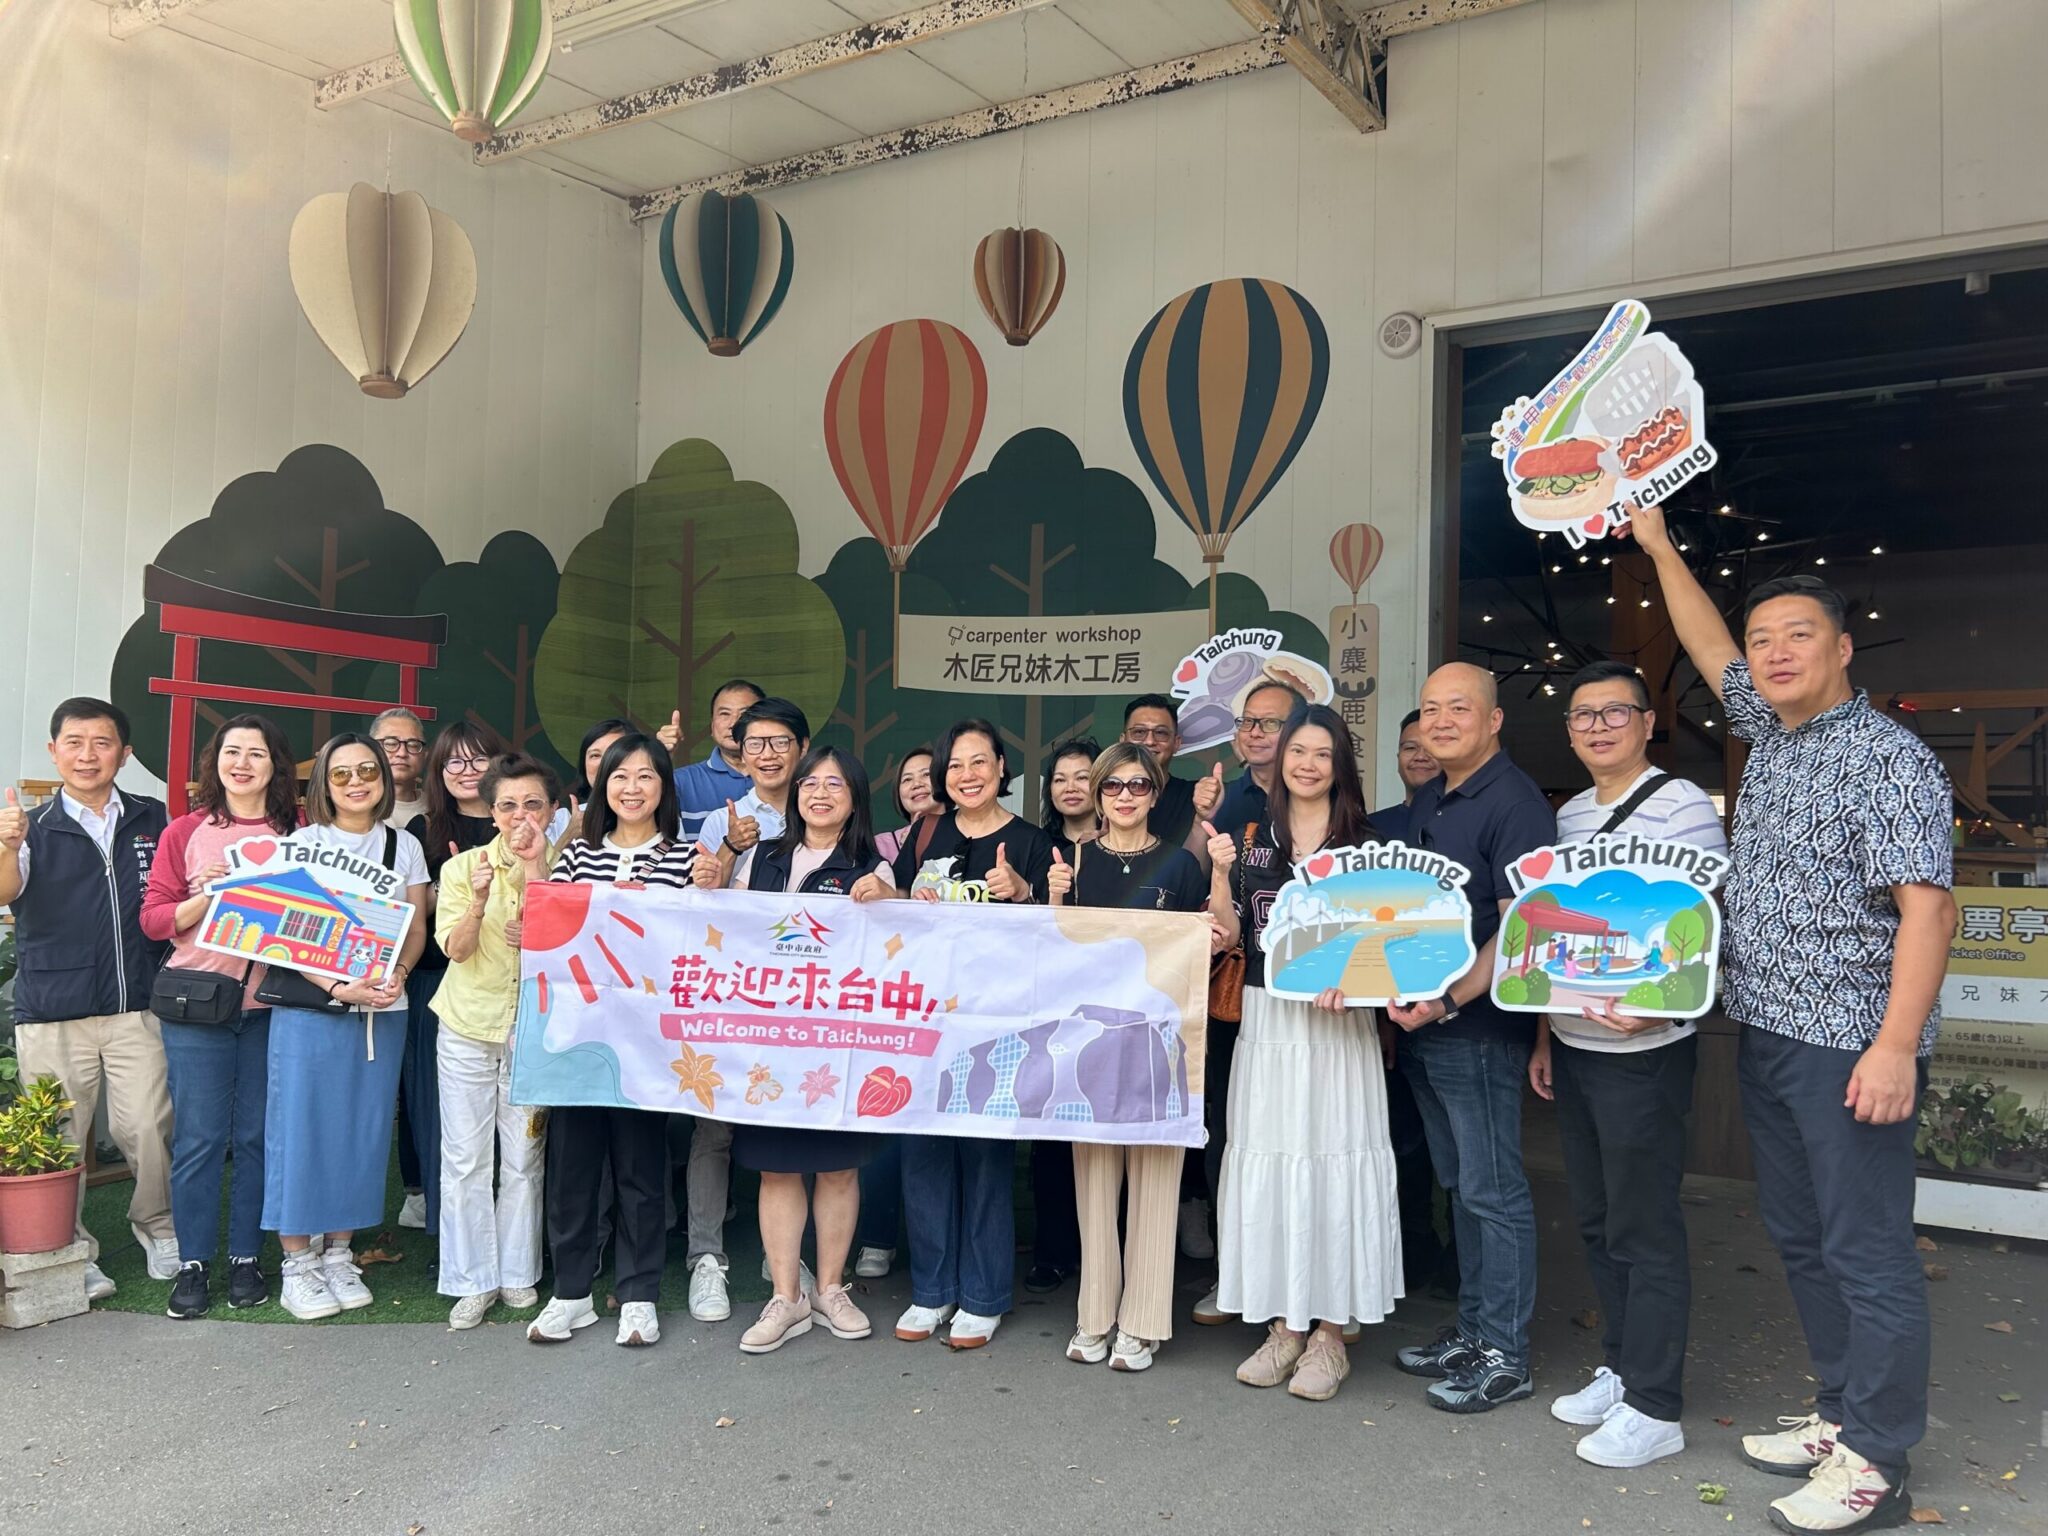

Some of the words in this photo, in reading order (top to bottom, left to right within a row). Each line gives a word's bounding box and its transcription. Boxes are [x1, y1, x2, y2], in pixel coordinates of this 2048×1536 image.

[1566, 527, 1581, 545] I
[966, 628, 1047, 646] carpenter
[1056, 626, 1141, 644] workshop
[1195, 632, 1277, 664] Taichung
[943, 652, 1141, 684] 木匠兄妹木工房
[230, 848, 240, 869] I
[280, 841, 398, 895] Taichung
[1301, 866, 1311, 886] I
[1336, 850, 1463, 891] Taichung
[1510, 866, 1525, 890] I
[1555, 836, 1723, 887] Taichung
[1950, 947, 1983, 959] icket
[1984, 948, 2025, 961] Office
[669, 954, 938, 1022] 歡迎來台中!
[681, 1019, 780, 1040] Welcome
[785, 1024, 807, 1041] to
[813, 1026, 915, 1049] Taichung!
